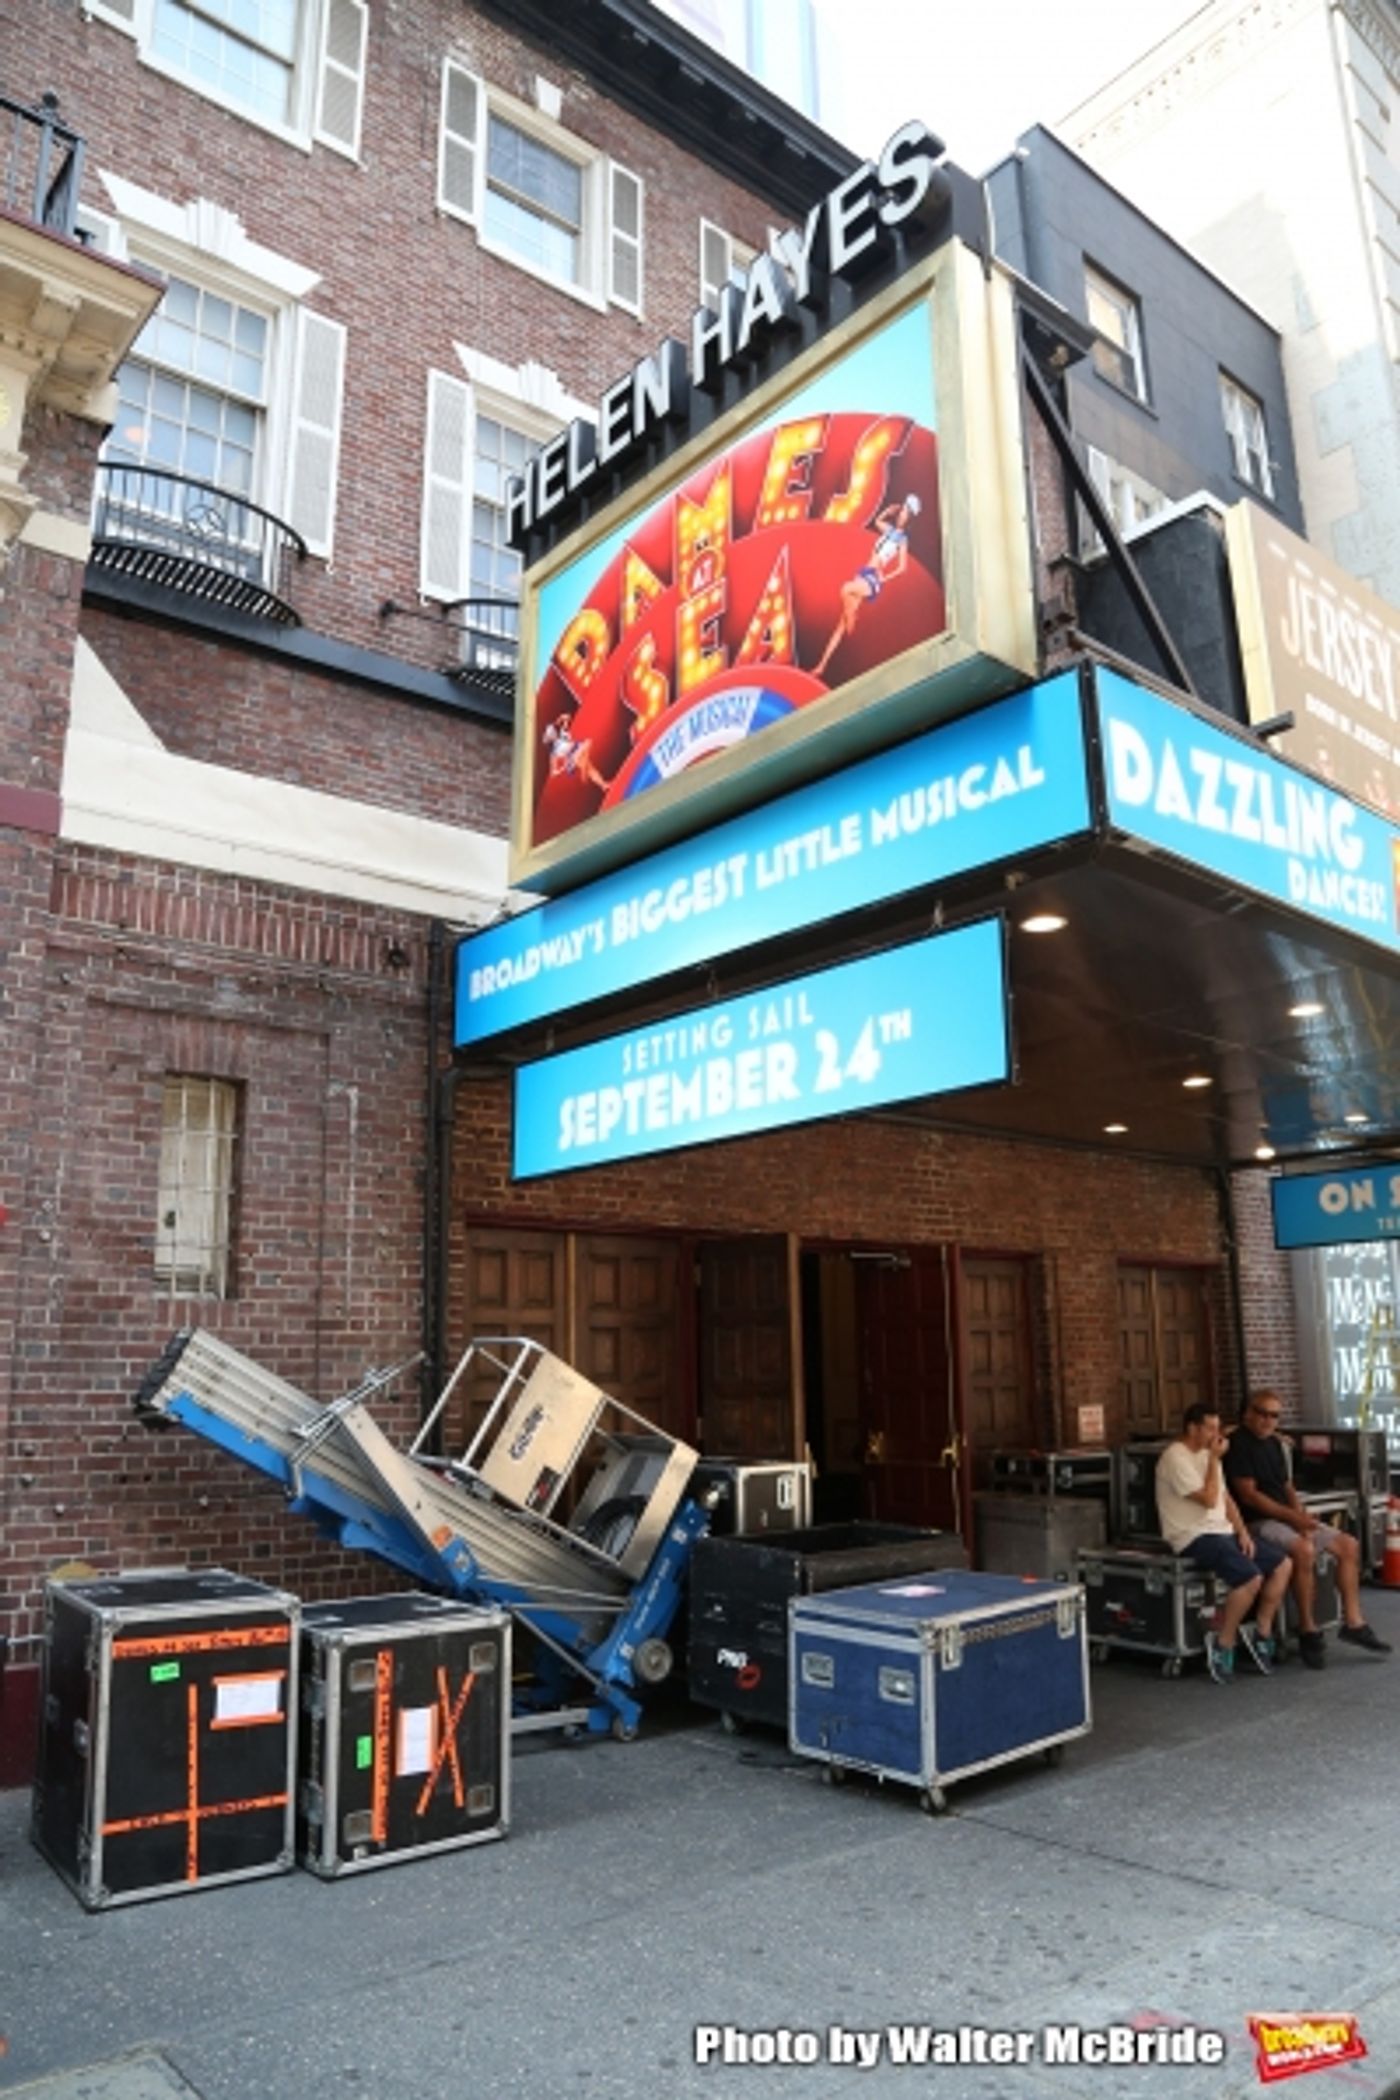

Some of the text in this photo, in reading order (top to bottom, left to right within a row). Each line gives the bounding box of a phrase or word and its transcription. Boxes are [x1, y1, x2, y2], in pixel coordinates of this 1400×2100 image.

[505, 119, 946, 546] HELEN HAYES
[555, 414, 912, 702] DAMES
[692, 556, 713, 592] AT
[622, 543, 796, 741] SEA
[1281, 575, 1398, 722] JERSEY
[657, 724, 685, 767] THE
[1108, 716, 1363, 869] DAZZLING
[469, 746, 1045, 1001] BROADWAY'S BIGGEST LITTLE MUSICAL
[557, 1009, 914, 1151] SEPTEMBER 24TH
[622, 991, 814, 1075] SETTING SAIL
[1319, 1180, 1377, 1214] ON
